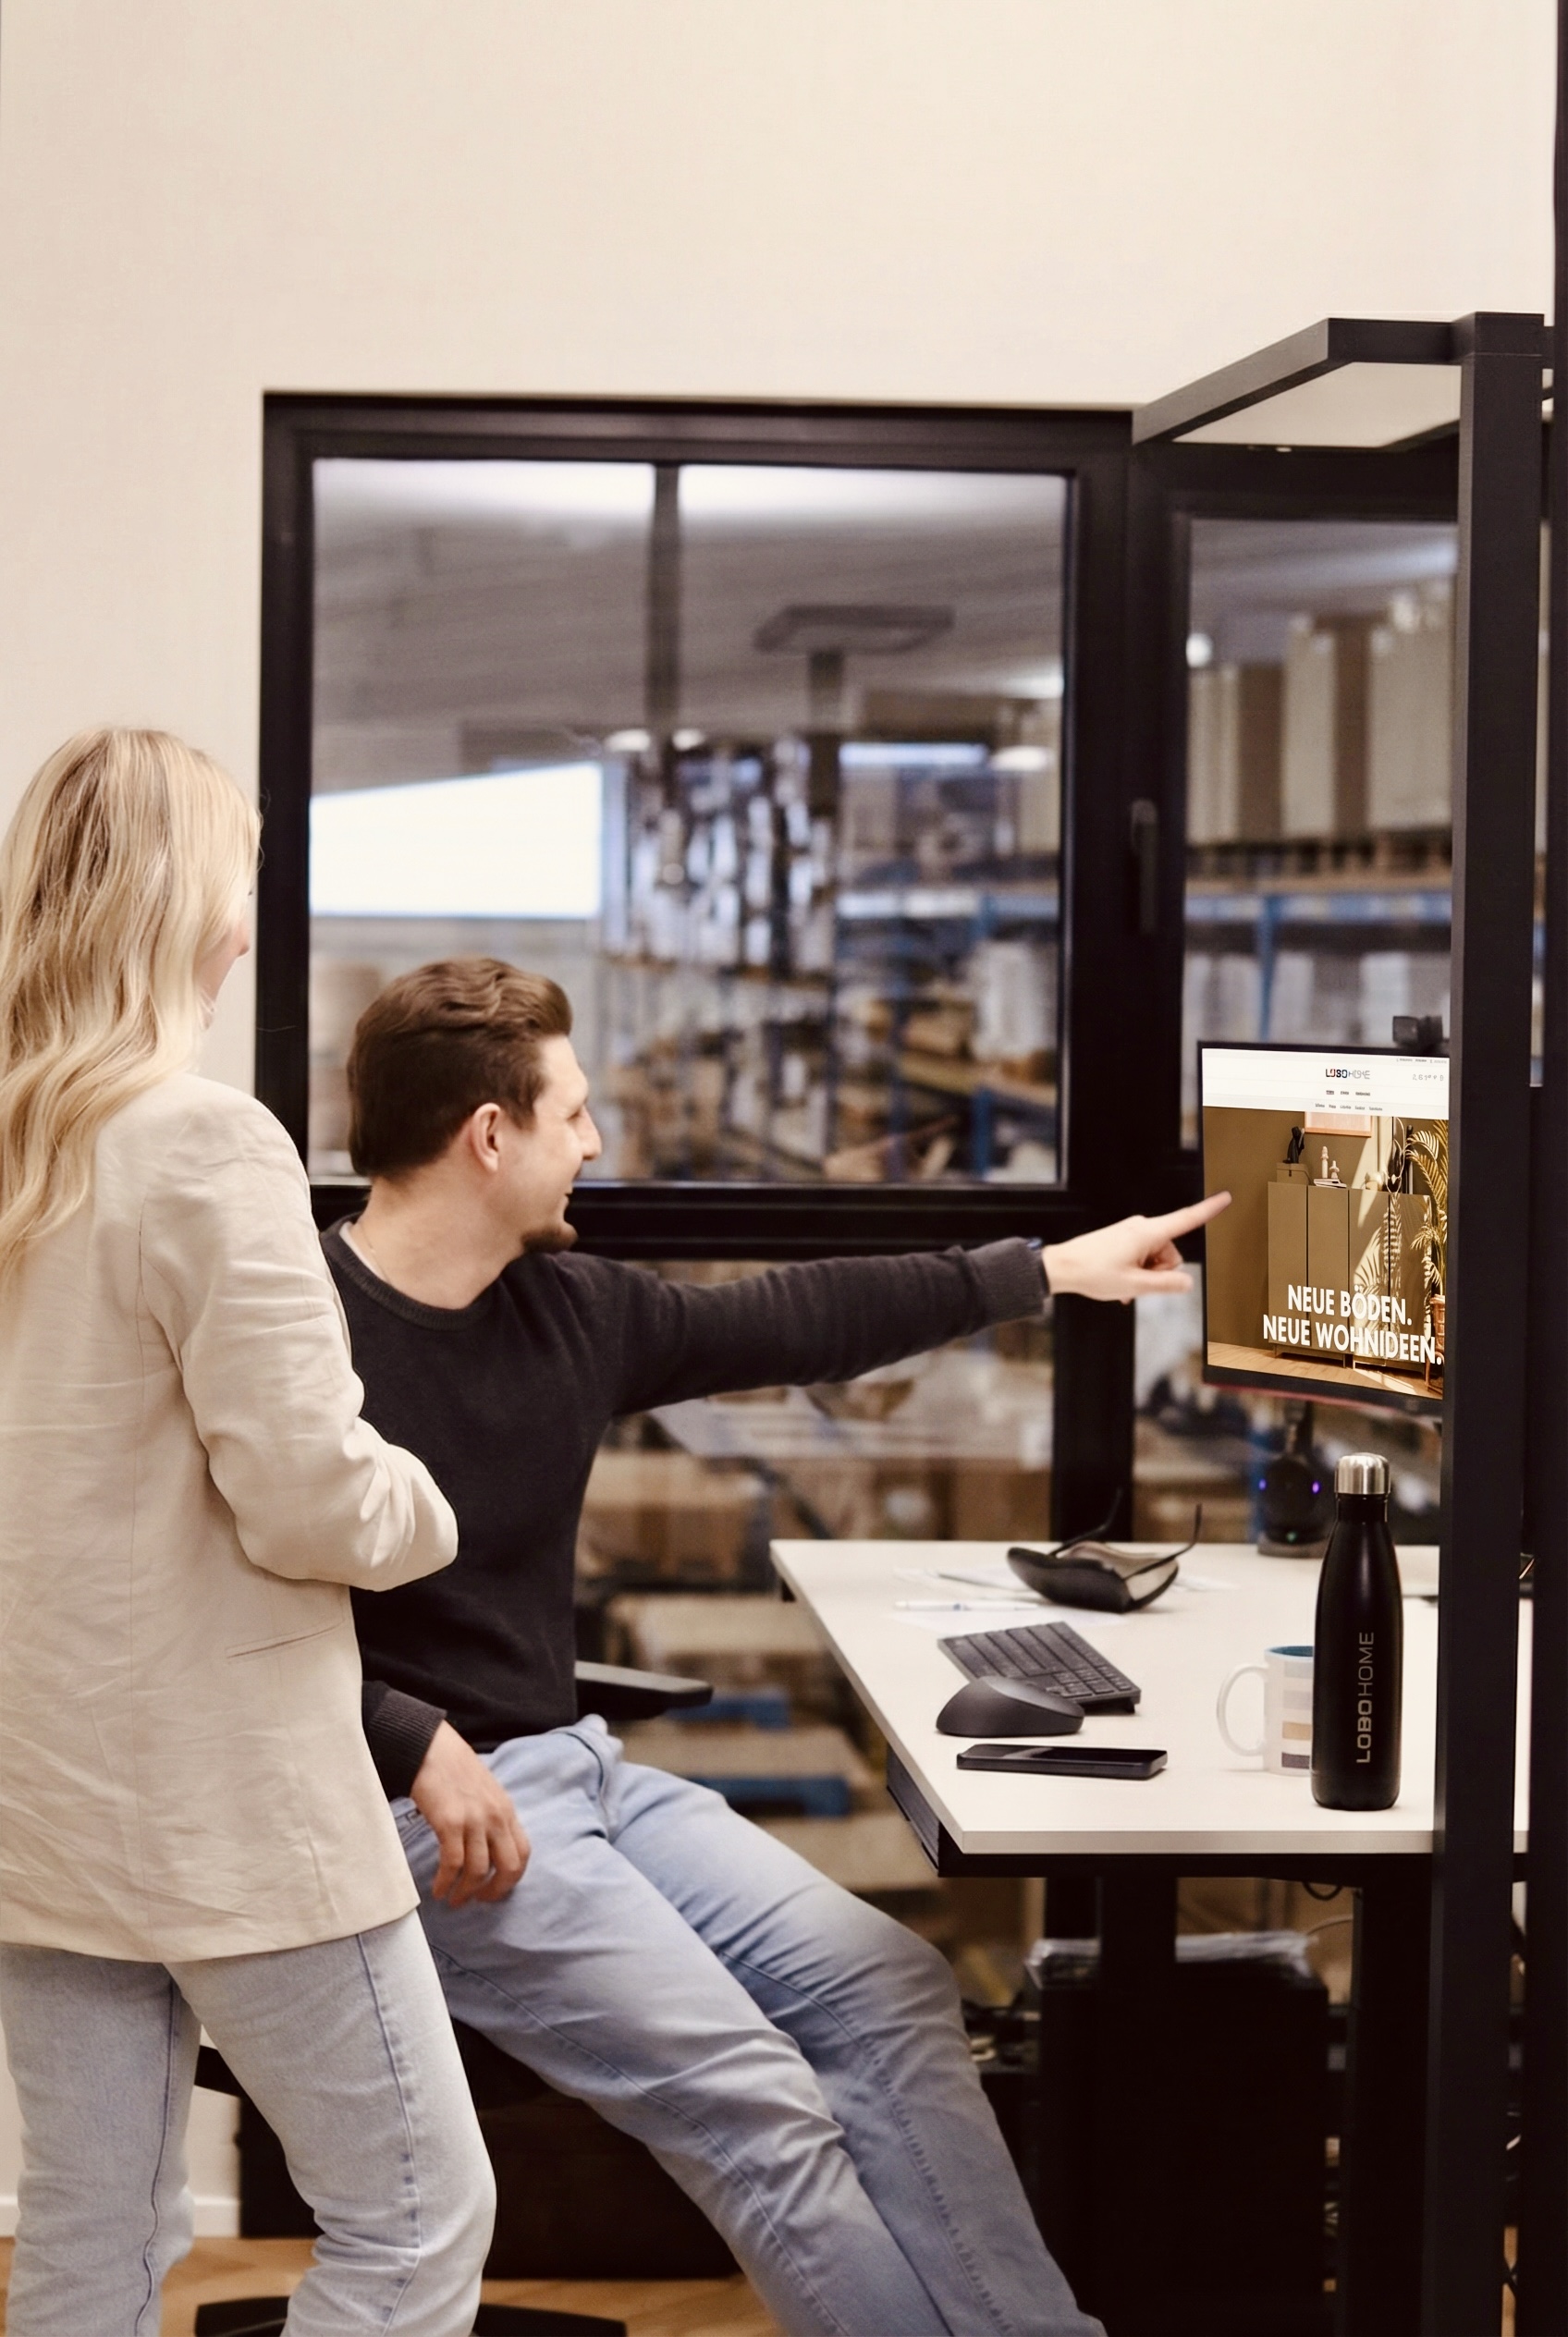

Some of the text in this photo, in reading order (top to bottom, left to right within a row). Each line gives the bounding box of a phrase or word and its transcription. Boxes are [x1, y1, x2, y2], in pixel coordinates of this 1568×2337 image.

[1288, 1284, 1413, 1326] NEUE BÖDEN.
[1263, 1314, 1442, 1365] NEUE WOHNIDEEN.
[1356, 1631, 1375, 1764] LOBOHOME
